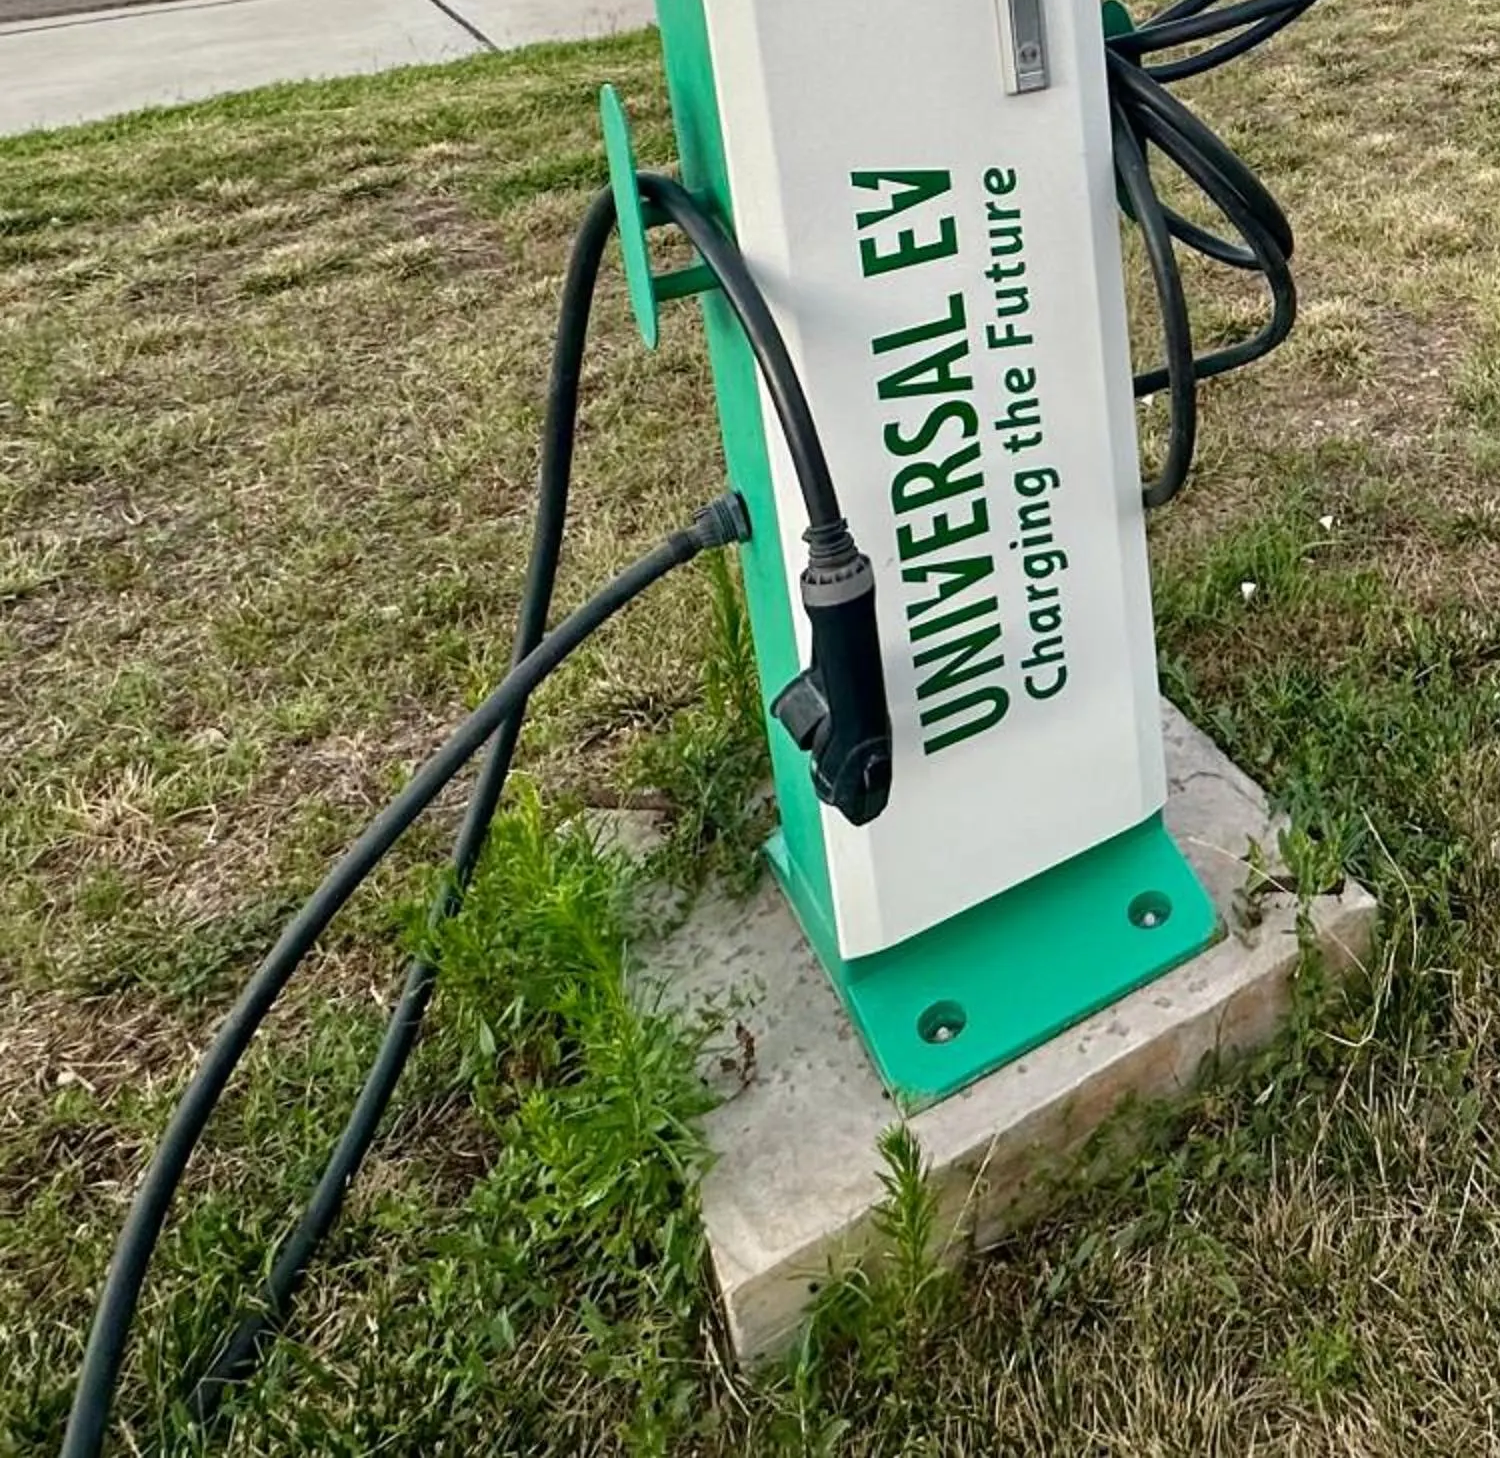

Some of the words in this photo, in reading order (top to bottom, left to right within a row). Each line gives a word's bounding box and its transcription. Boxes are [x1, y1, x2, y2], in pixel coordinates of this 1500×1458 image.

[850, 169, 959, 278] EV
[983, 166, 1034, 350] Future
[995, 364, 1043, 453] the
[871, 291, 1011, 756] UNIVERSAL
[1009, 466, 1068, 700] Charging
